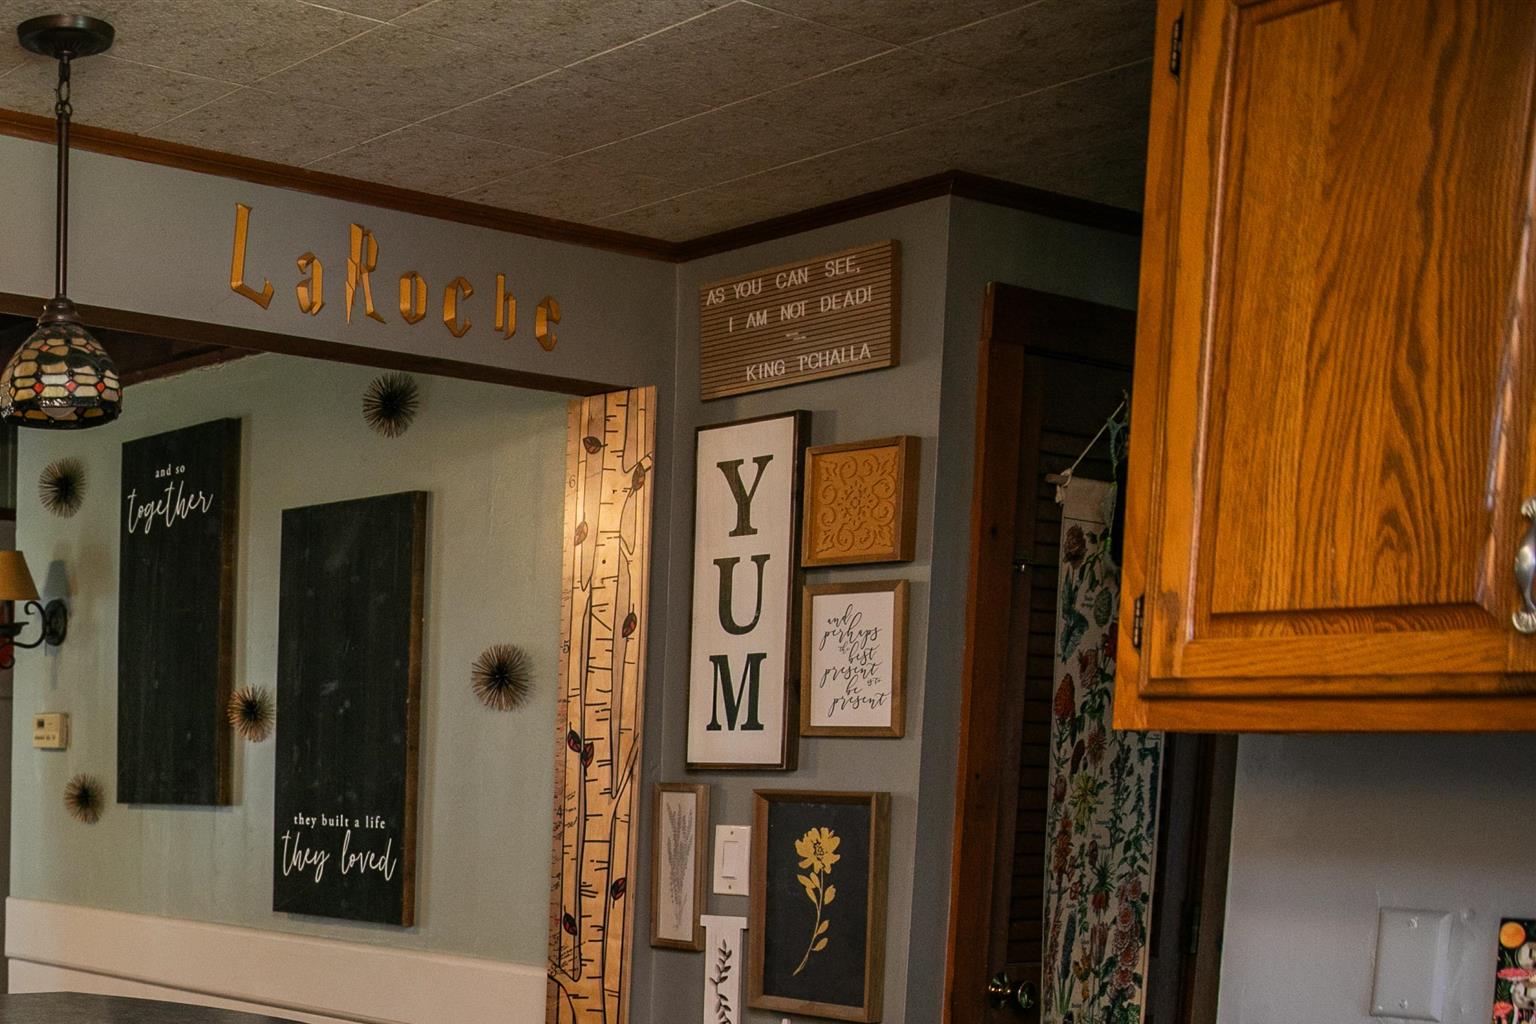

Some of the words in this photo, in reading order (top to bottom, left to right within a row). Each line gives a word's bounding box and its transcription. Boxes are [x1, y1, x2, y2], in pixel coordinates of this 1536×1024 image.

[229, 202, 562, 353] LaRoche
[706, 287, 725, 306] AS
[733, 278, 762, 299] YOU
[776, 267, 808, 289] CAN
[824, 255, 861, 278] SEE,
[728, 316, 733, 333] I
[745, 309, 768, 329] AM
[780, 300, 808, 321] NOT
[745, 359, 786, 382] KING
[155, 464, 172, 479] and
[175, 465, 186, 475] so
[127, 480, 214, 534] together
[706, 454, 774, 731] YUM
[827, 603, 853, 628] and
[819, 611, 883, 651] perhaps
[848, 640, 880, 666] best
[819, 661, 883, 689] present
[845, 674, 863, 695] be
[827, 691, 892, 718] present
[293, 812, 317, 829] they
[321, 813, 350, 827] built
[354, 819, 361, 828] a
[365, 815, 386, 829] life
[281, 830, 331, 883] they
[341, 829, 397, 881] loved
